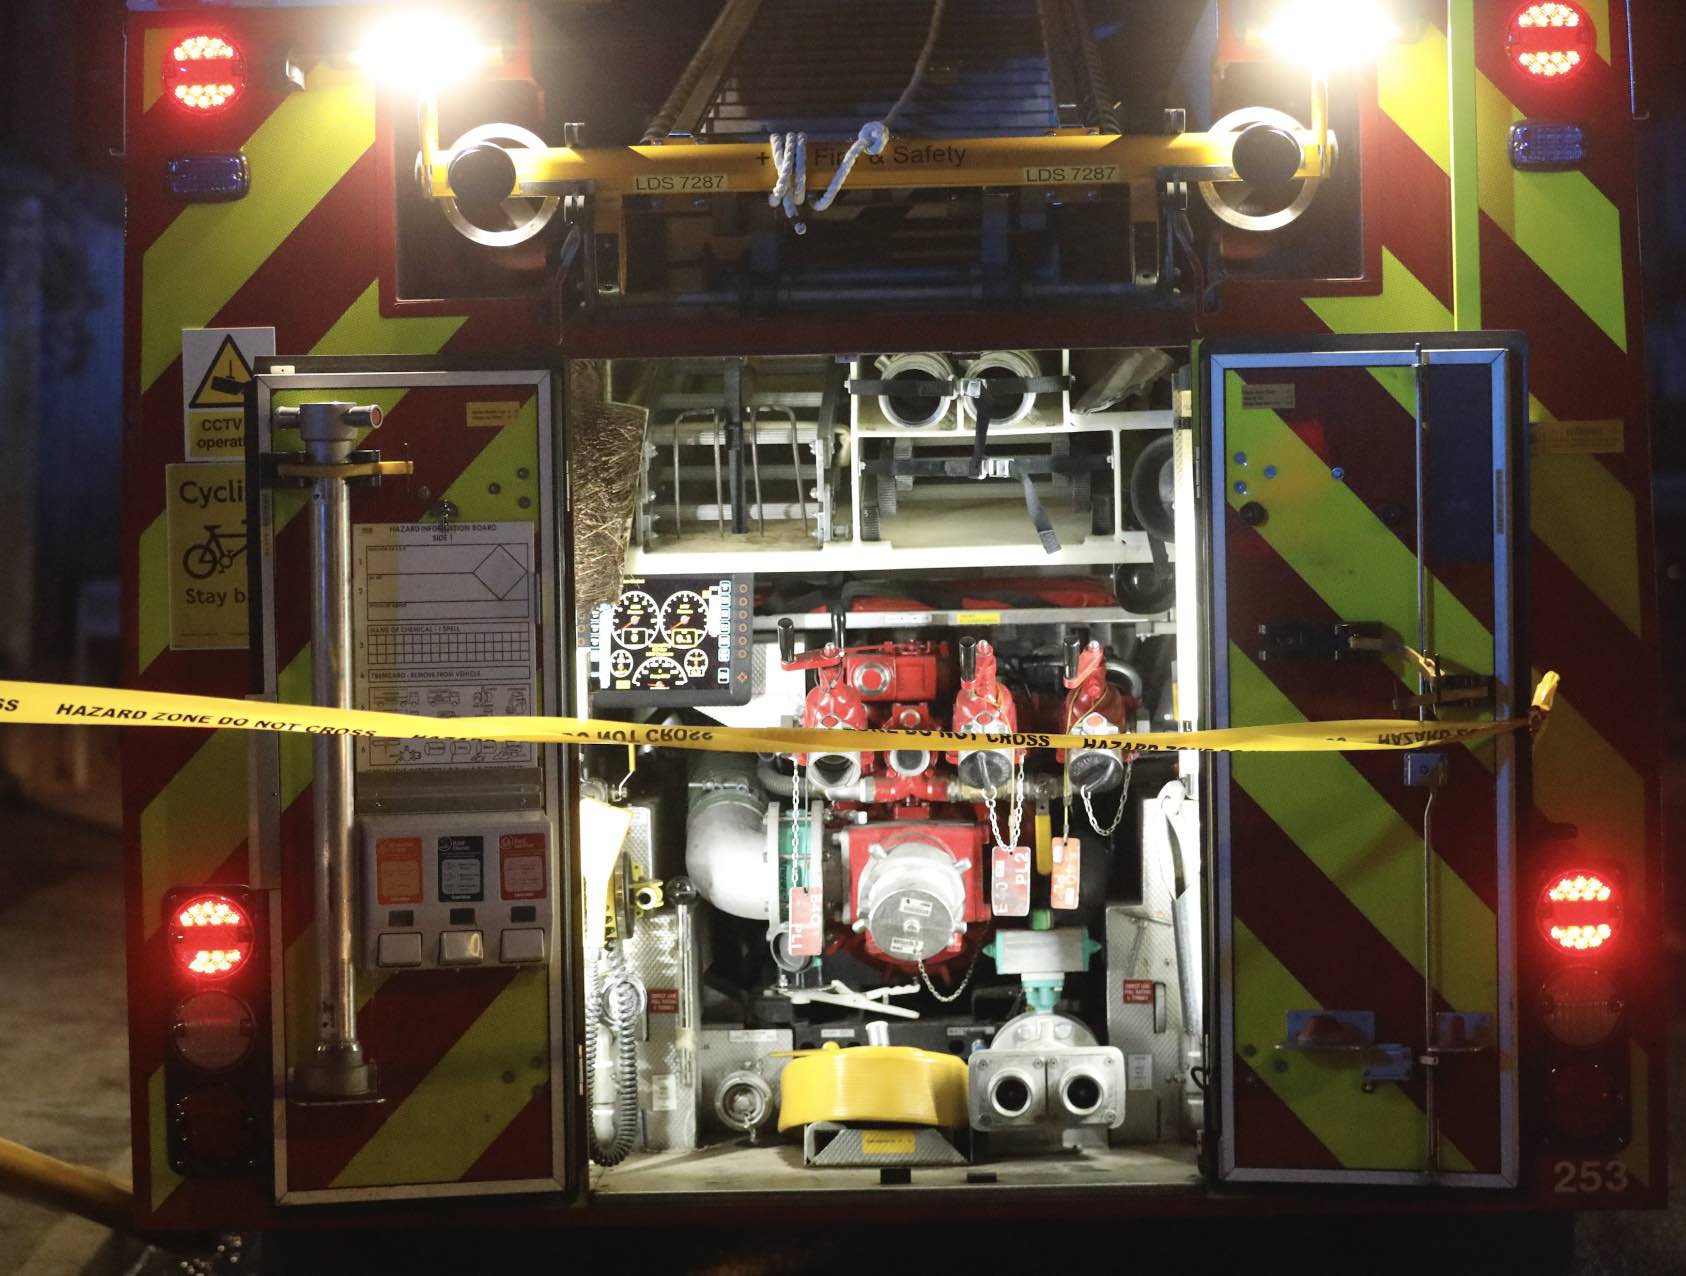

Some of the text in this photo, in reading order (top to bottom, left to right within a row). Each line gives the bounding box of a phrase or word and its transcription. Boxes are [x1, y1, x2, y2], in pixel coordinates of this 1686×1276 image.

[815, 148, 847, 166] Fir
[893, 145, 967, 168] Safety
[635, 175, 724, 190] LDS 7287
[1026, 167, 1116, 182] LDS 7287
[202, 418, 242, 431] CCTV
[180, 480, 243, 508] Cycli
[472, 523, 497, 532] BOARD
[432, 534, 448, 542] SIDE
[185, 588, 228, 607] Stay
[56, 703, 377, 736] HAZARD ZONE DO NOT CROSS
[986, 733, 1051, 747] CROSS
[1014, 852, 1030, 885] PL2
[1553, 1160, 1629, 1193] 253
